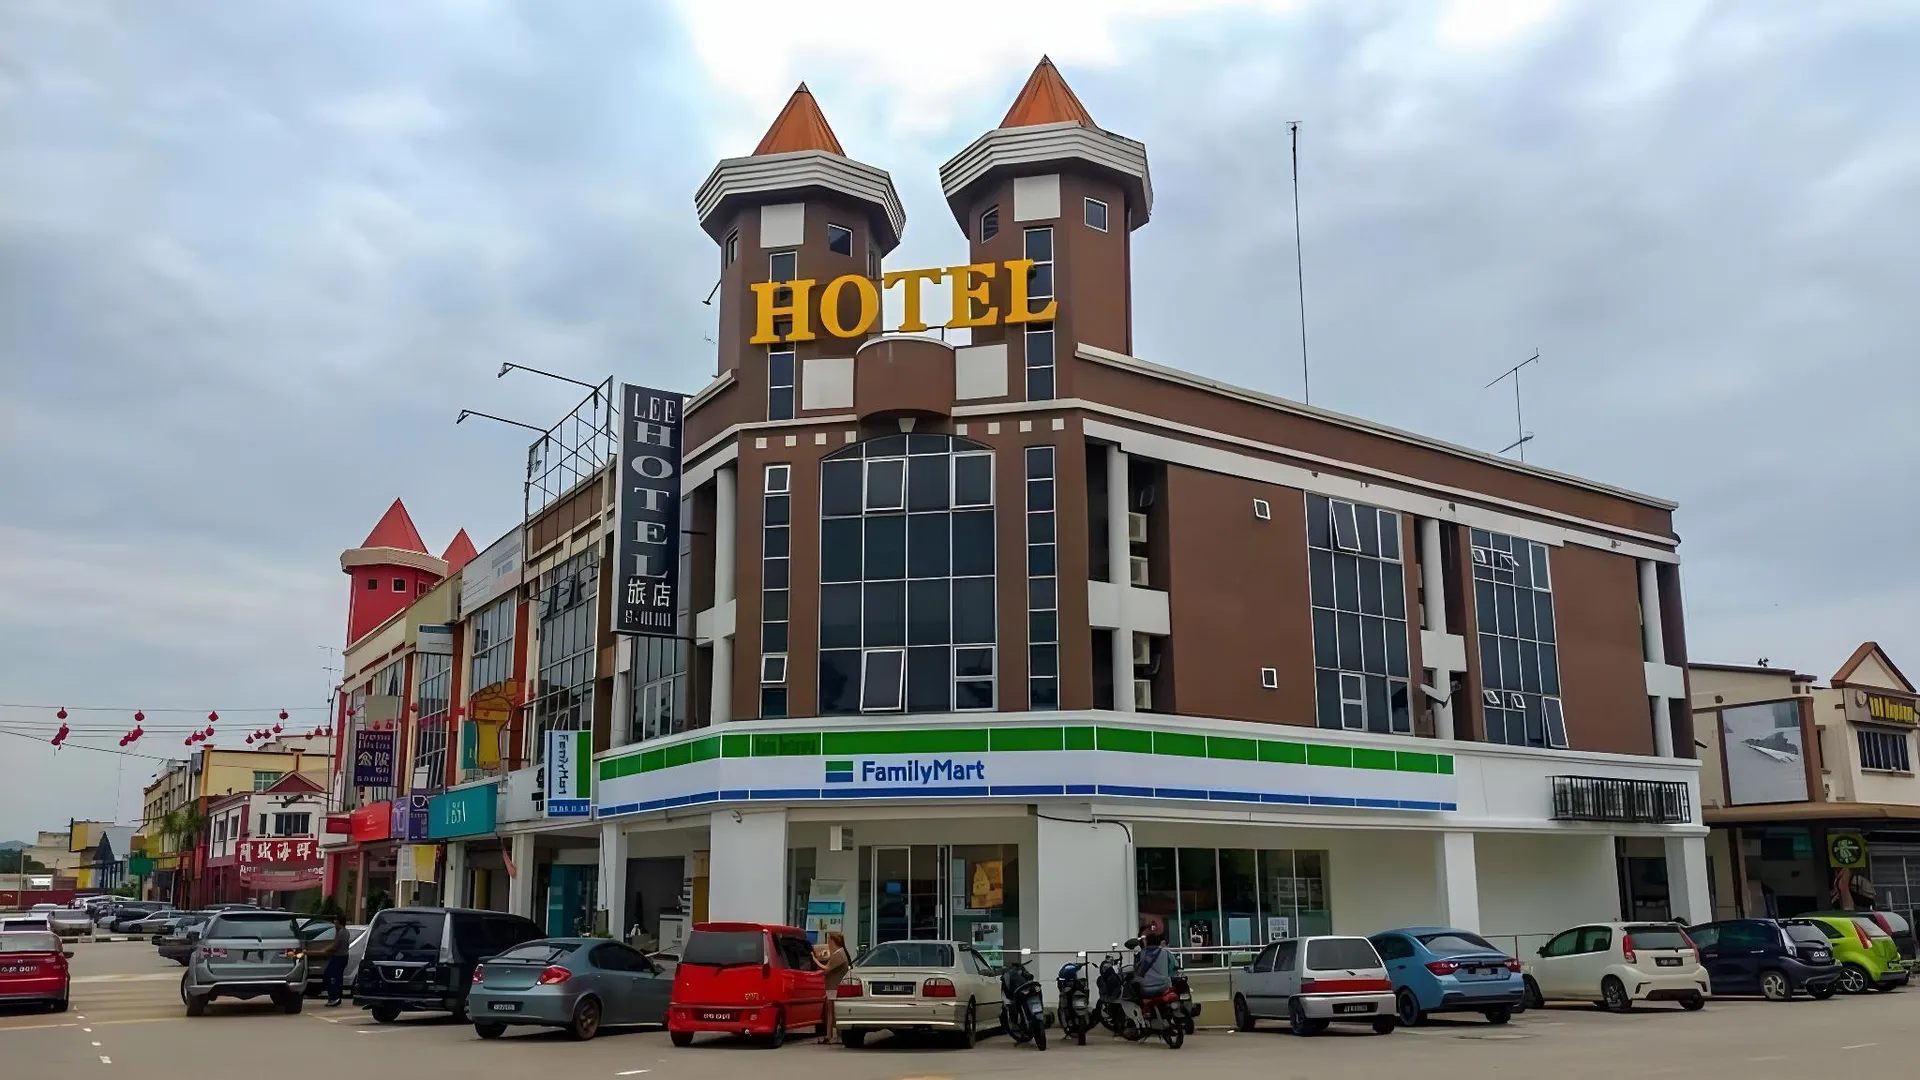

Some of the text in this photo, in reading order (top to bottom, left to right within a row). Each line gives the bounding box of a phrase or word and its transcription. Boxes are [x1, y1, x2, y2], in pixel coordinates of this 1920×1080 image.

[750, 259, 1058, 345] HOTEL
[633, 392, 676, 424] LEE
[631, 420, 675, 579] HOTEL
[627, 577, 671, 608] 旅店
[862, 759, 985, 785] FamilyMart
